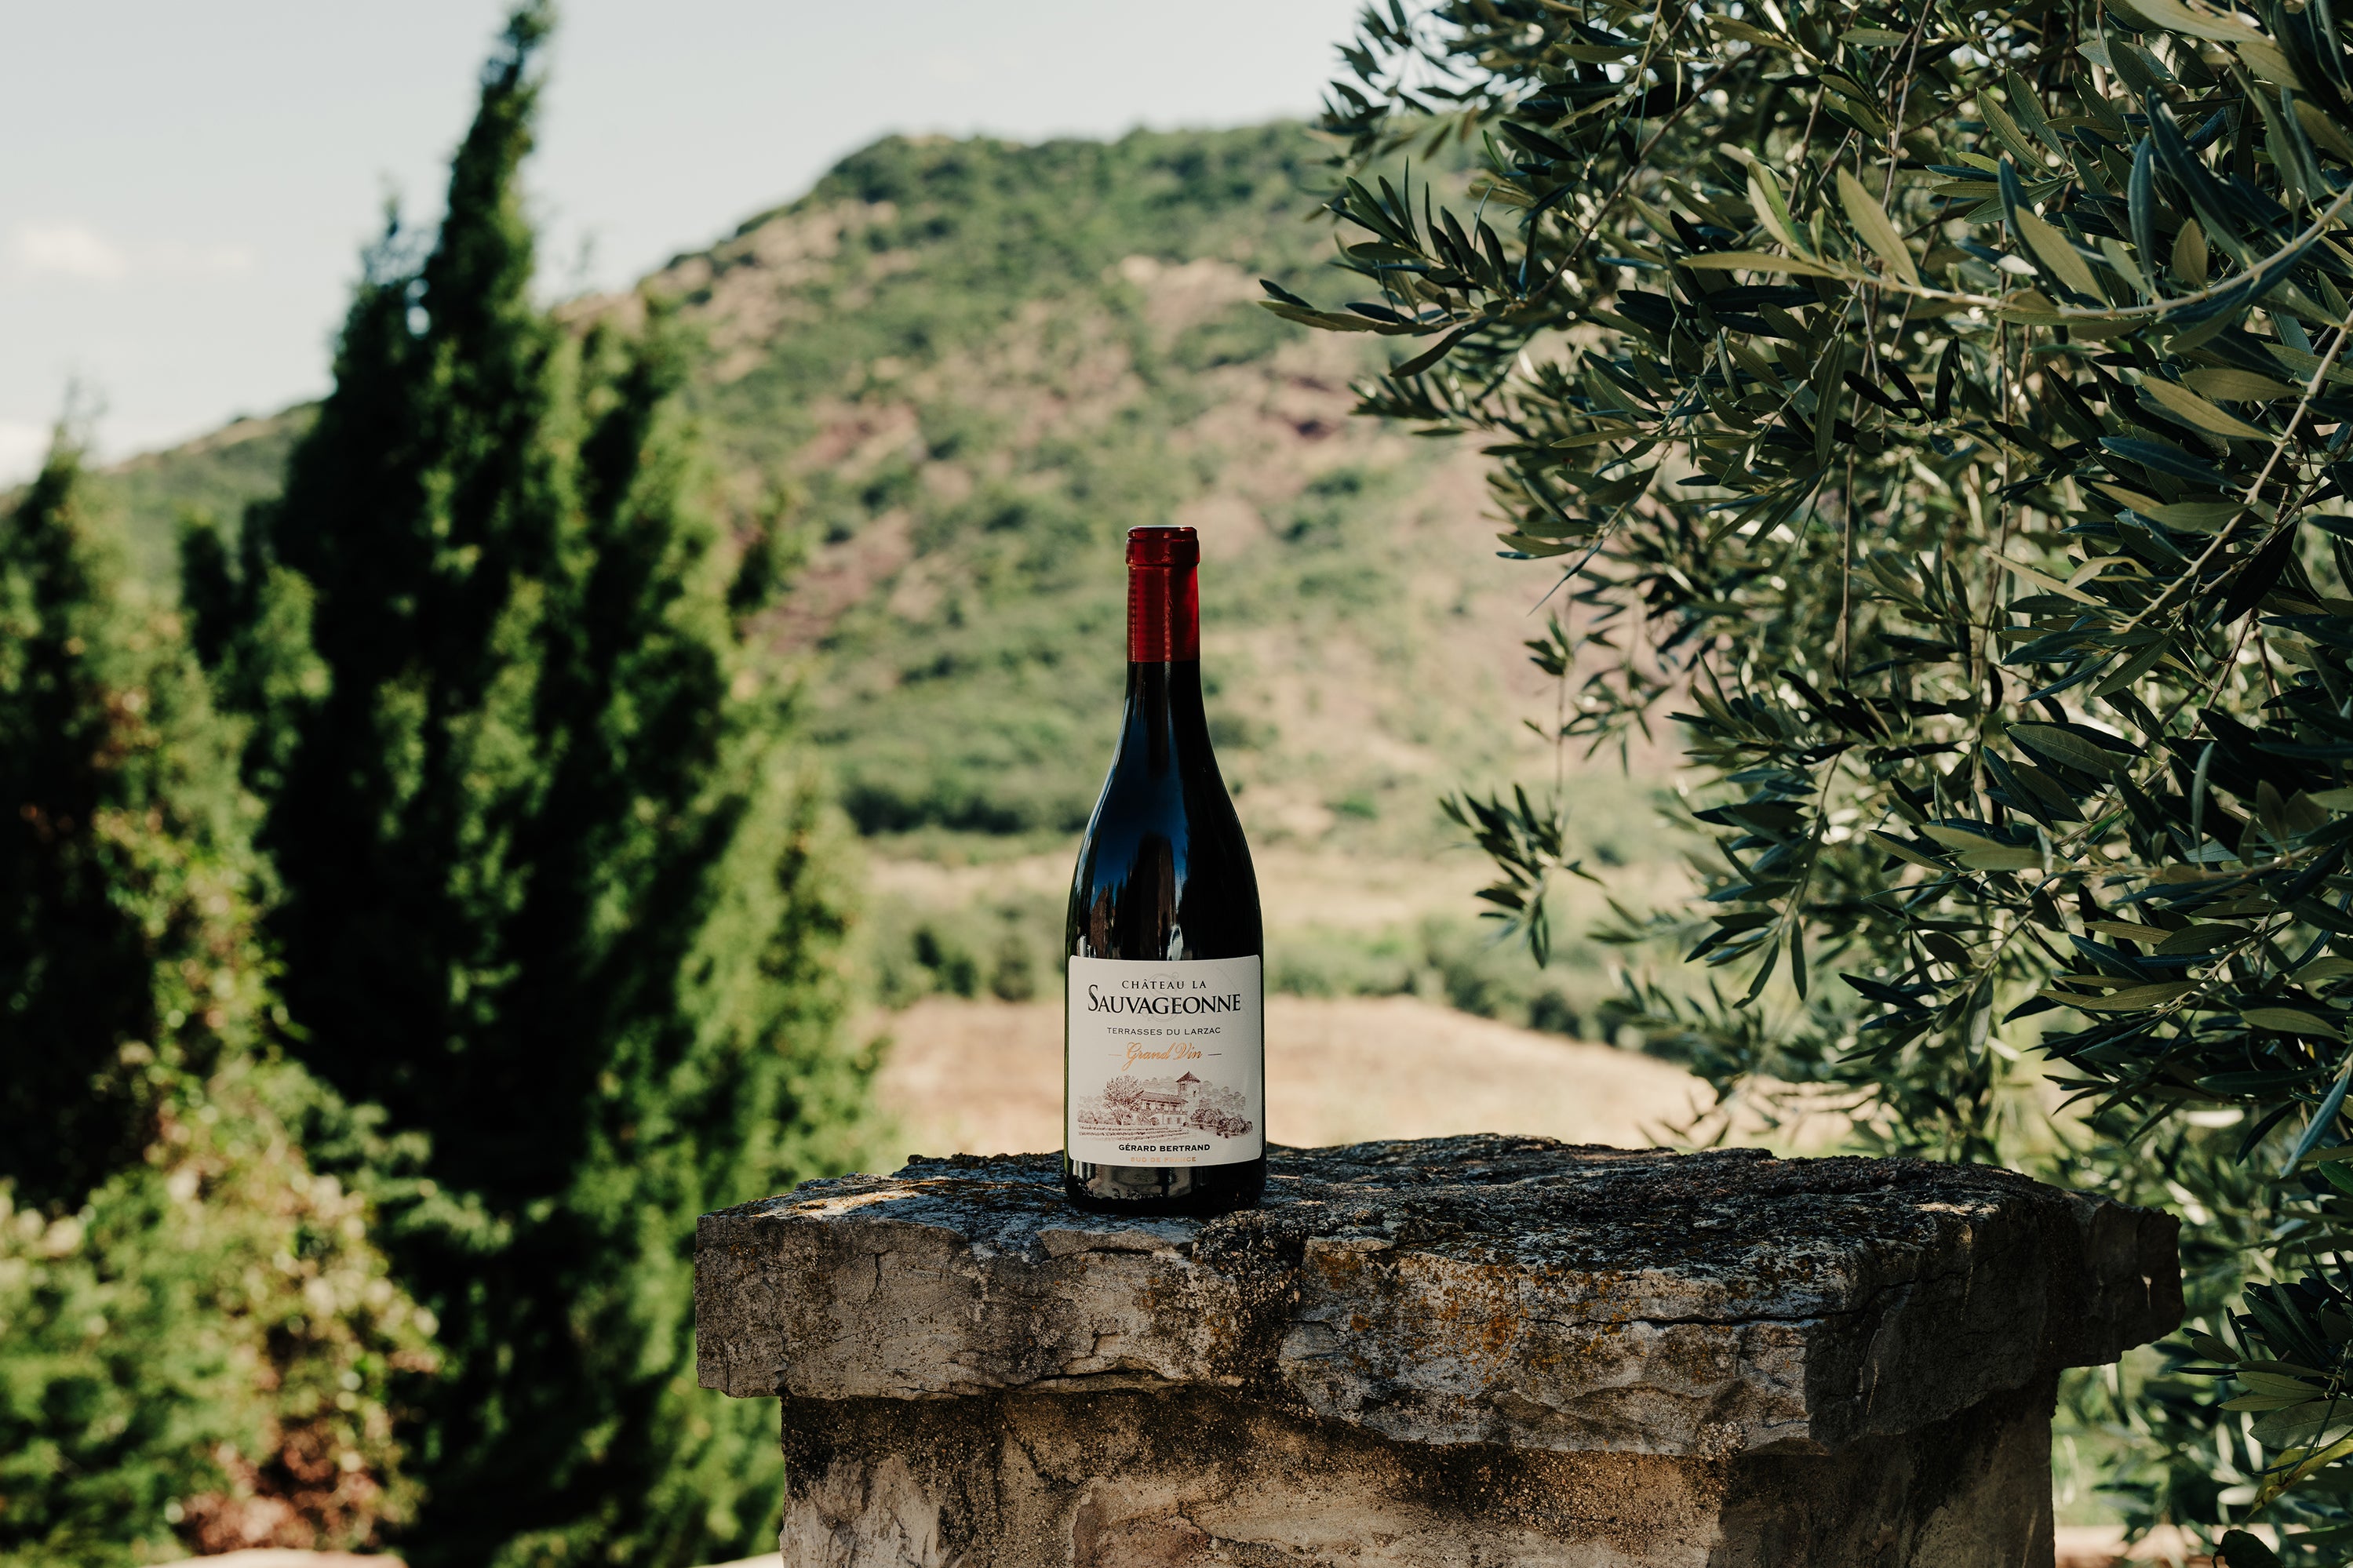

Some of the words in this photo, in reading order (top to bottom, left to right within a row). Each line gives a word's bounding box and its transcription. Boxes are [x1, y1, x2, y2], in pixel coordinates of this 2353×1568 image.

[1122, 979, 1184, 989] CHÂTEAU
[1087, 984, 1241, 1014] SAUVAGEONNE
[1107, 1027, 1163, 1035] TERRASSES
[1184, 1027, 1221, 1035] LARZAC
[1121, 1042, 1176, 1071] Grand
[1175, 1042, 1203, 1060] Vin
[1118, 1143, 1156, 1151] GÉRARD
